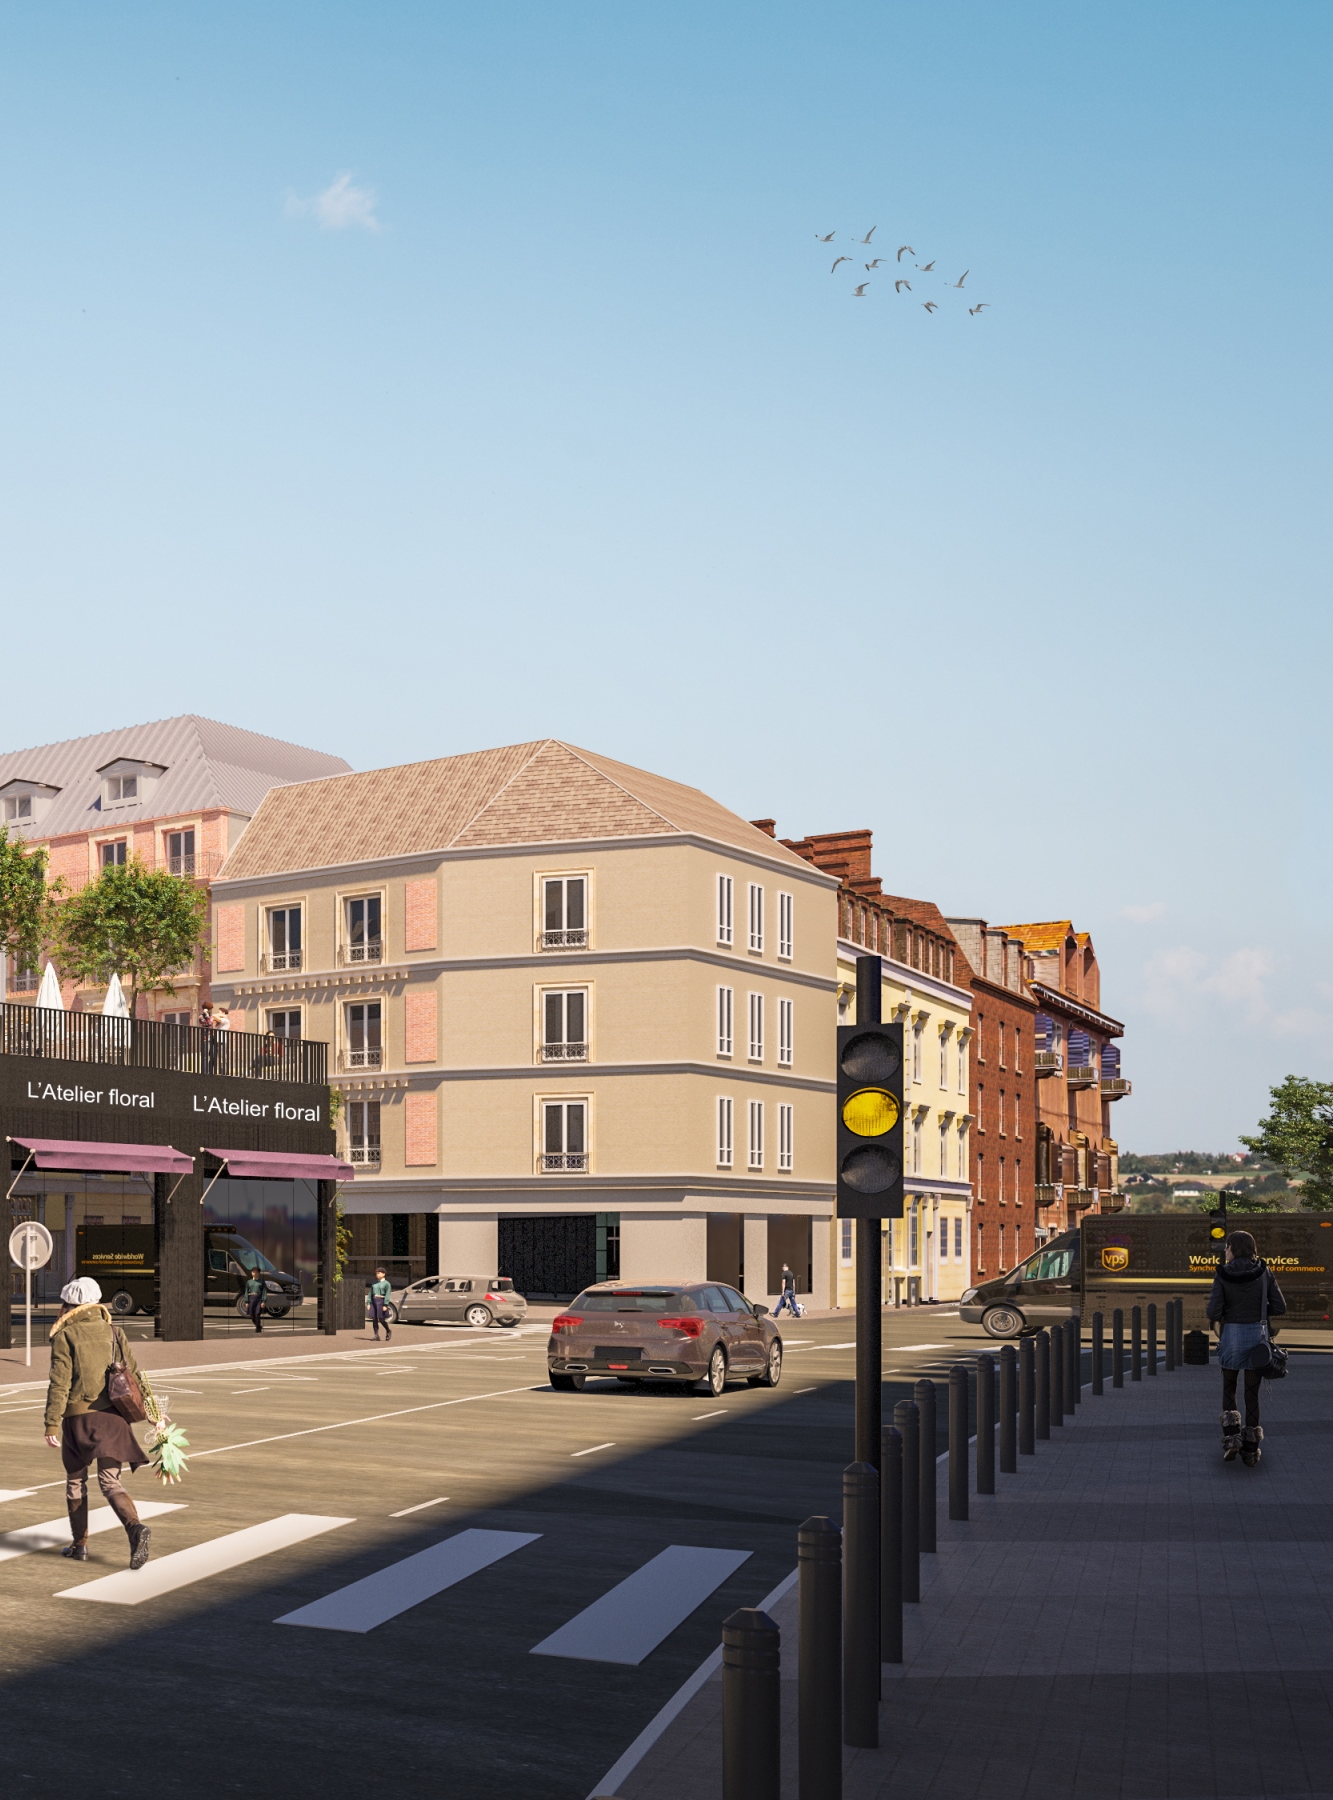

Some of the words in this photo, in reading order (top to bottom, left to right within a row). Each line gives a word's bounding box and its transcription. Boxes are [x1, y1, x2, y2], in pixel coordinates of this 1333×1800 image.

[108, 1088, 155, 1109] floral
[273, 1101, 321, 1122] floral
[1276, 1264, 1284, 1272] of
